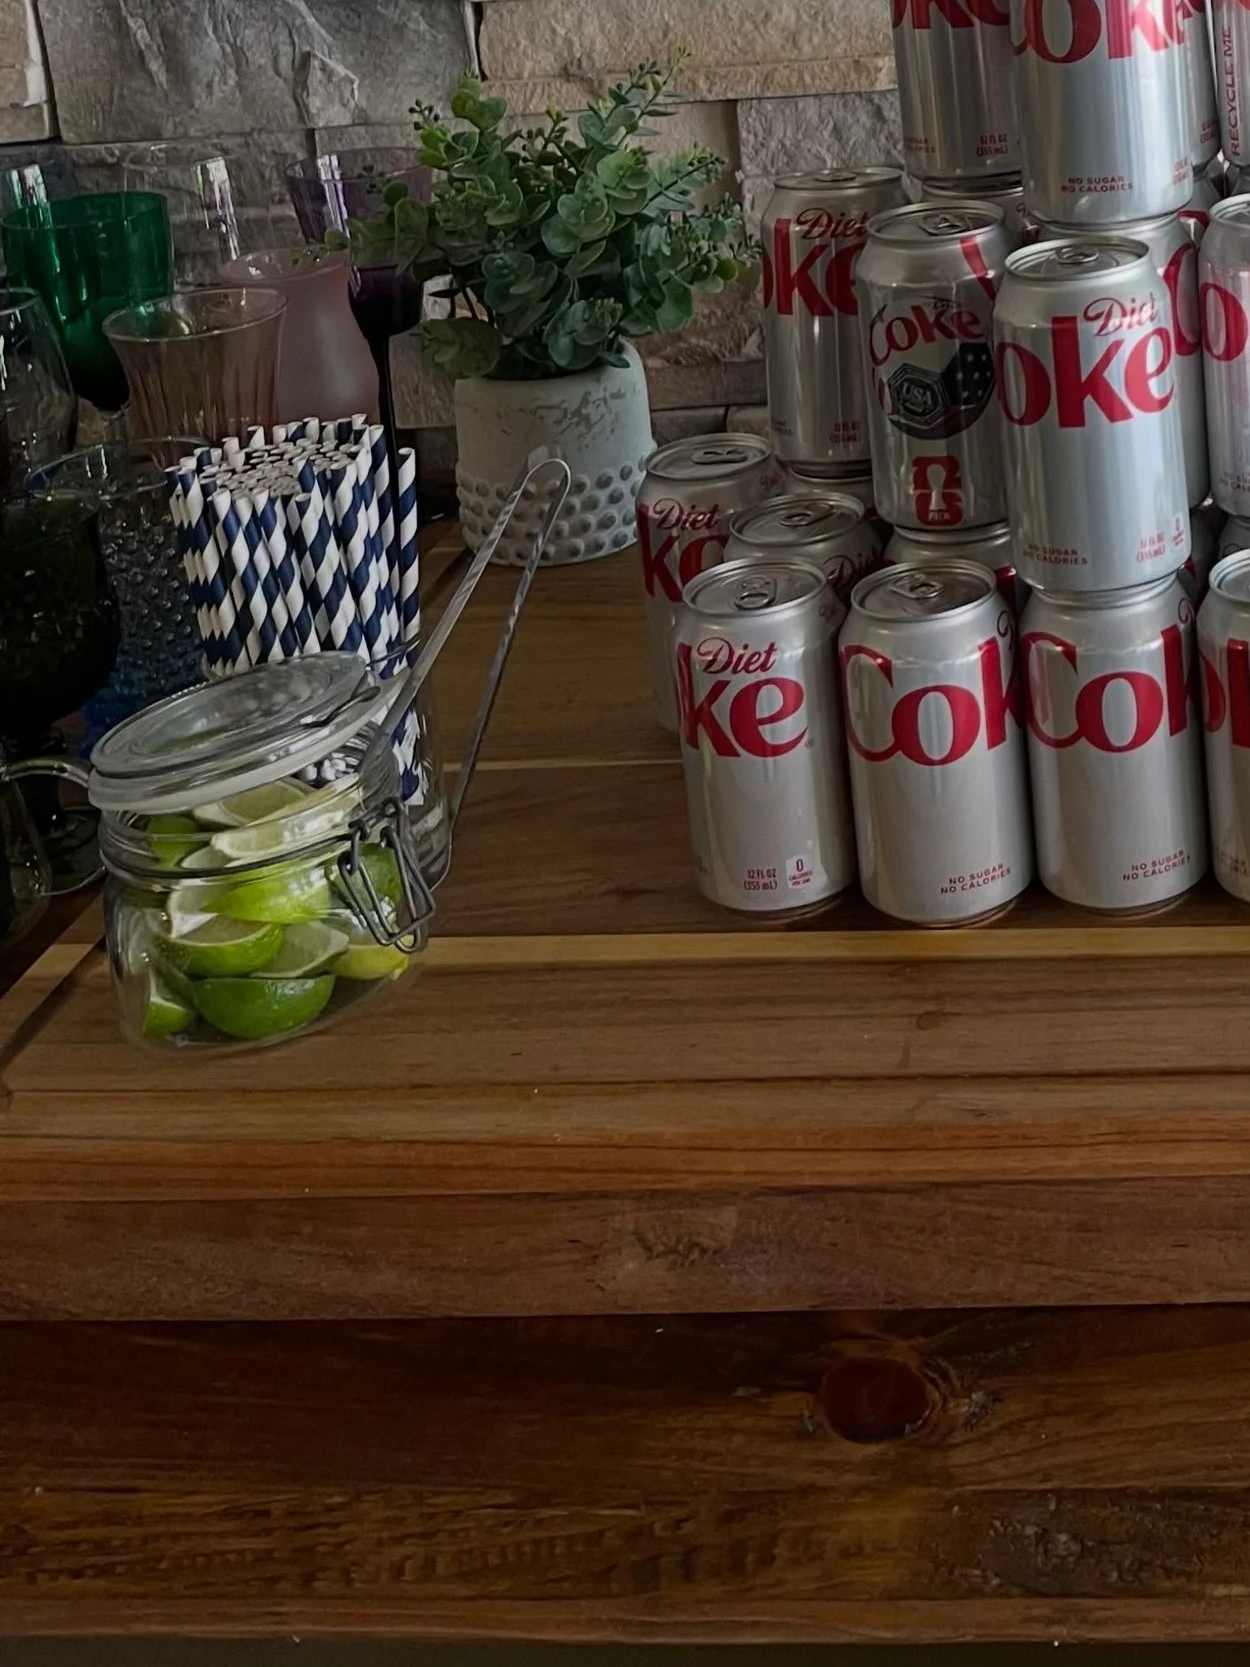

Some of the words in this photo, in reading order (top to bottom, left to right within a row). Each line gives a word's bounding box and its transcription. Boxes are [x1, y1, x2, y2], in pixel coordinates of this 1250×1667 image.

[1224, 61, 1241, 156] RECYCLE
[1068, 177, 1083, 185] NO
[1087, 175, 1125, 185] SUGAR
[1079, 182, 1133, 194] CALORIES
[796, 207, 869, 240] Diet
[1083, 293, 1158, 337] Diet
[870, 303, 985, 366] Coke
[997, 315, 1175, 428] oke
[901, 380, 932, 408] USA
[653, 497, 721, 531] Diet
[1036, 554, 1087, 566] CALORIES
[1042, 545, 1078, 556] SUGAR
[697, 636, 777, 674] Diet
[676, 642, 808, 758] ke
[839, 636, 1023, 767] Cok
[1020, 624, 1197, 753] Cok
[747, 869, 755, 879] 12
[756, 869, 765, 879] FL
[767, 868, 777, 878] OZ
[796, 858, 804, 872] 0
[949, 875, 965, 885] NO
[969, 863, 1004, 881] SUGAR
[1122, 872, 1139, 882] NO
[1143, 854, 1191, 878] CALORIES
[1131, 862, 1147, 872] NO
[1151, 849, 1185, 867] SUGAR
[743, 880, 760, 891] (355
[762, 879, 778, 890] mL)
[940, 885, 956, 894] NO
[961, 867, 1011, 892] CALORIES
